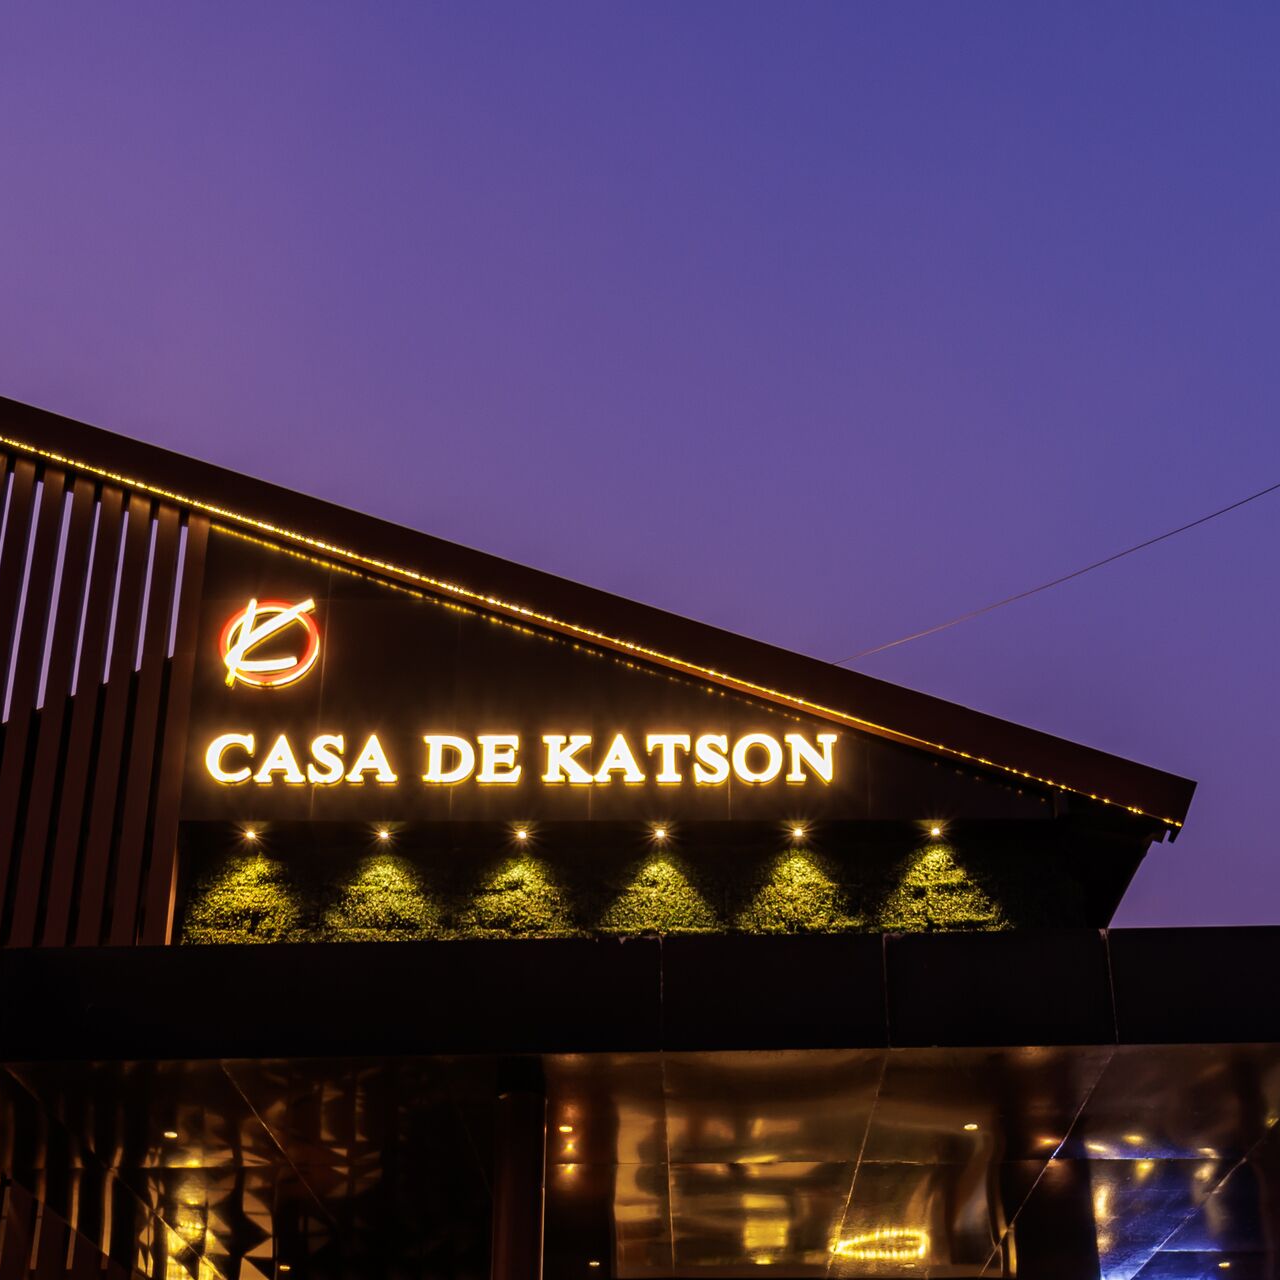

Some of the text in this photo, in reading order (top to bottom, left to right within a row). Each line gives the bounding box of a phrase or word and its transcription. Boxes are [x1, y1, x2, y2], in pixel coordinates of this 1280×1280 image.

[205, 732, 839, 785] CASA DE KATSON
